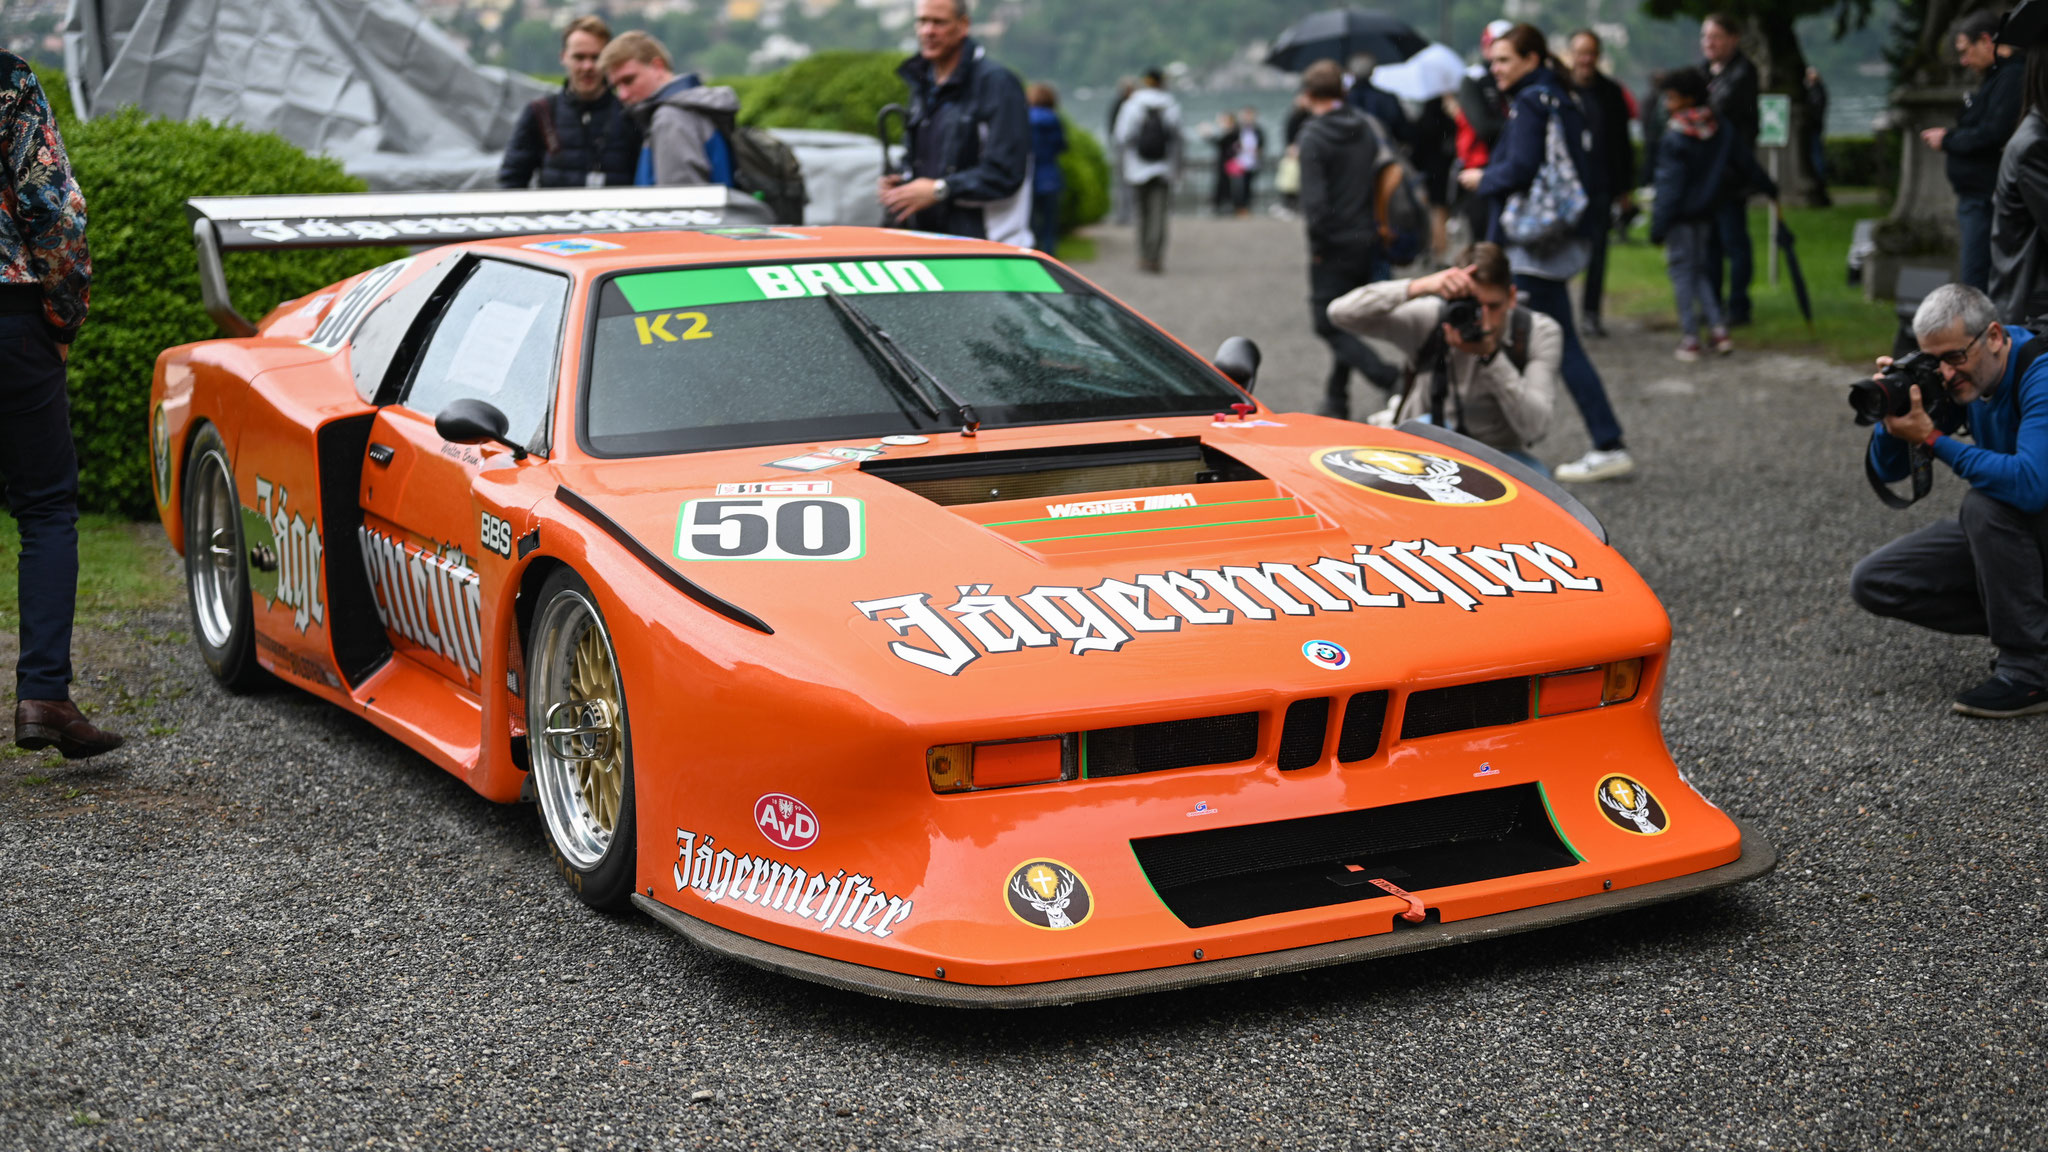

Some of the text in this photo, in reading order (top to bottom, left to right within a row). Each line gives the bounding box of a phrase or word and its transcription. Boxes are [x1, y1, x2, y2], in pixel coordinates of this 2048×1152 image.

[747, 260, 943, 299] BRUN
[635, 312, 712, 345] K2
[691, 499, 851, 557] 50
[1046, 500, 1137, 519] WAGNER
[481, 511, 512, 560] BBS
[760, 804, 816, 842] AvD
